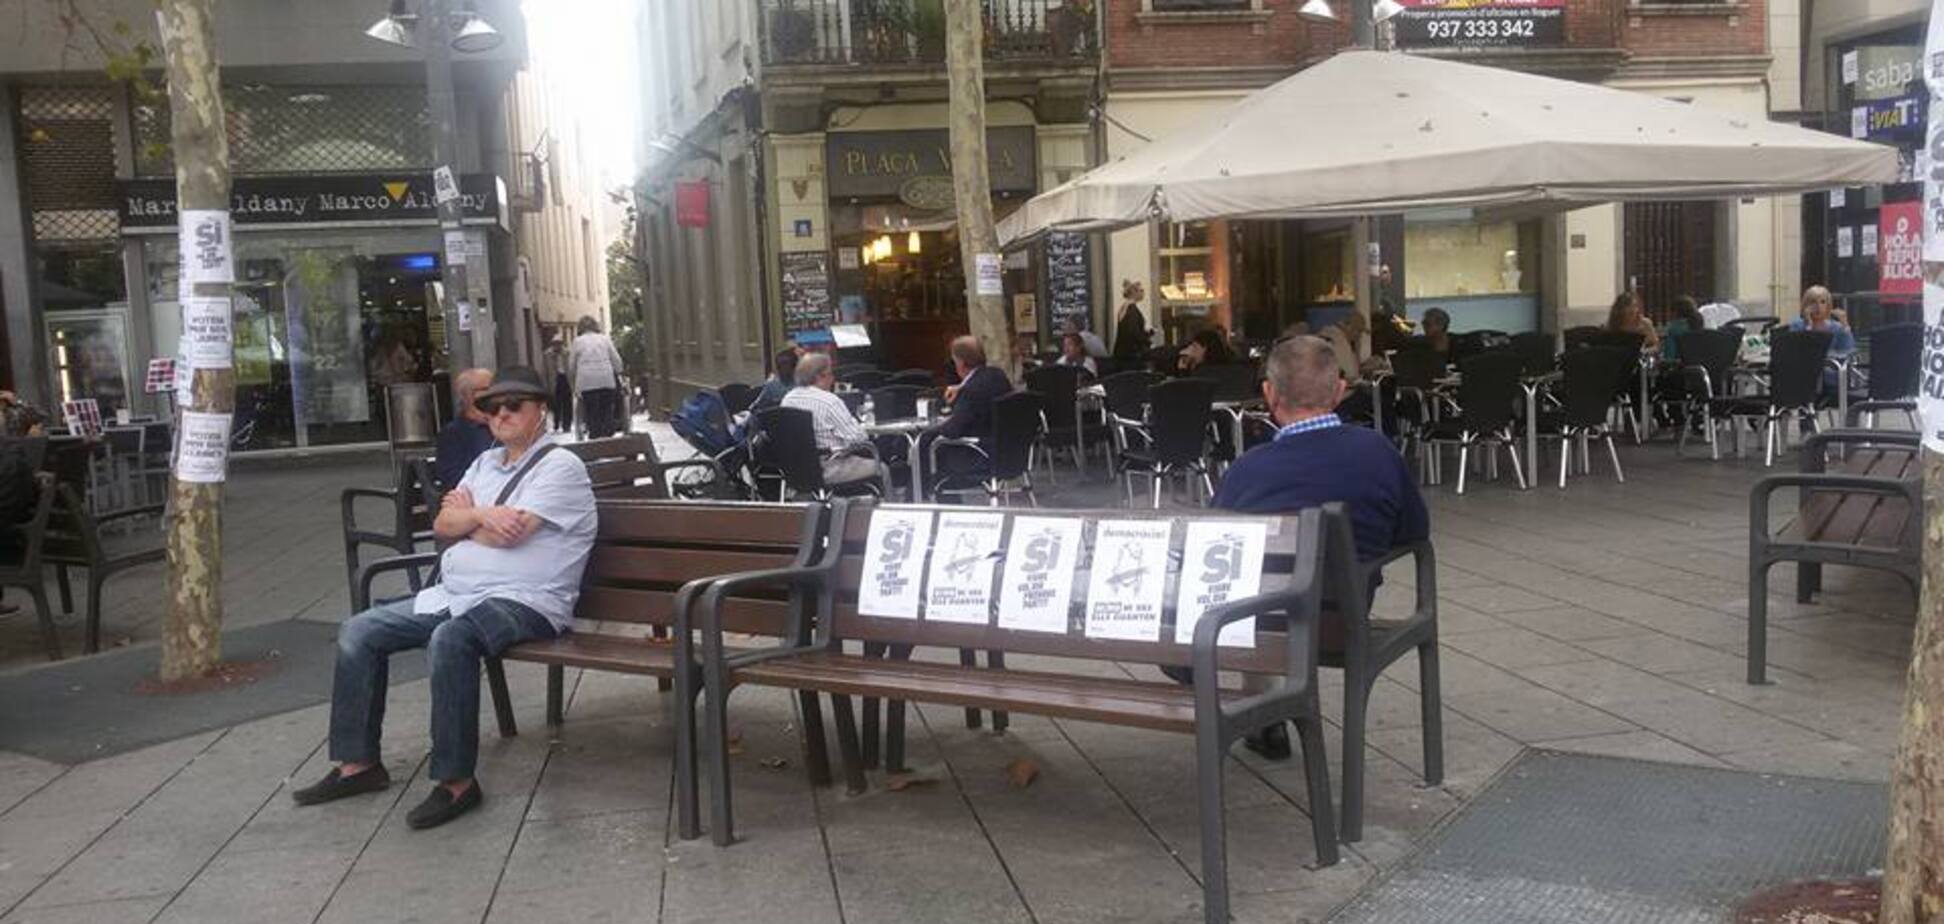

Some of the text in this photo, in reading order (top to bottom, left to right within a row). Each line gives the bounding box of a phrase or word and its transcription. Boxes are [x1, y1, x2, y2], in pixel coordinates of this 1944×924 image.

[1427, 20, 1534, 39] 937 333 342
[1864, 58, 1912, 91] saba
[319, 193, 391, 212] Marco
[1884, 232, 1921, 248] HOLA
